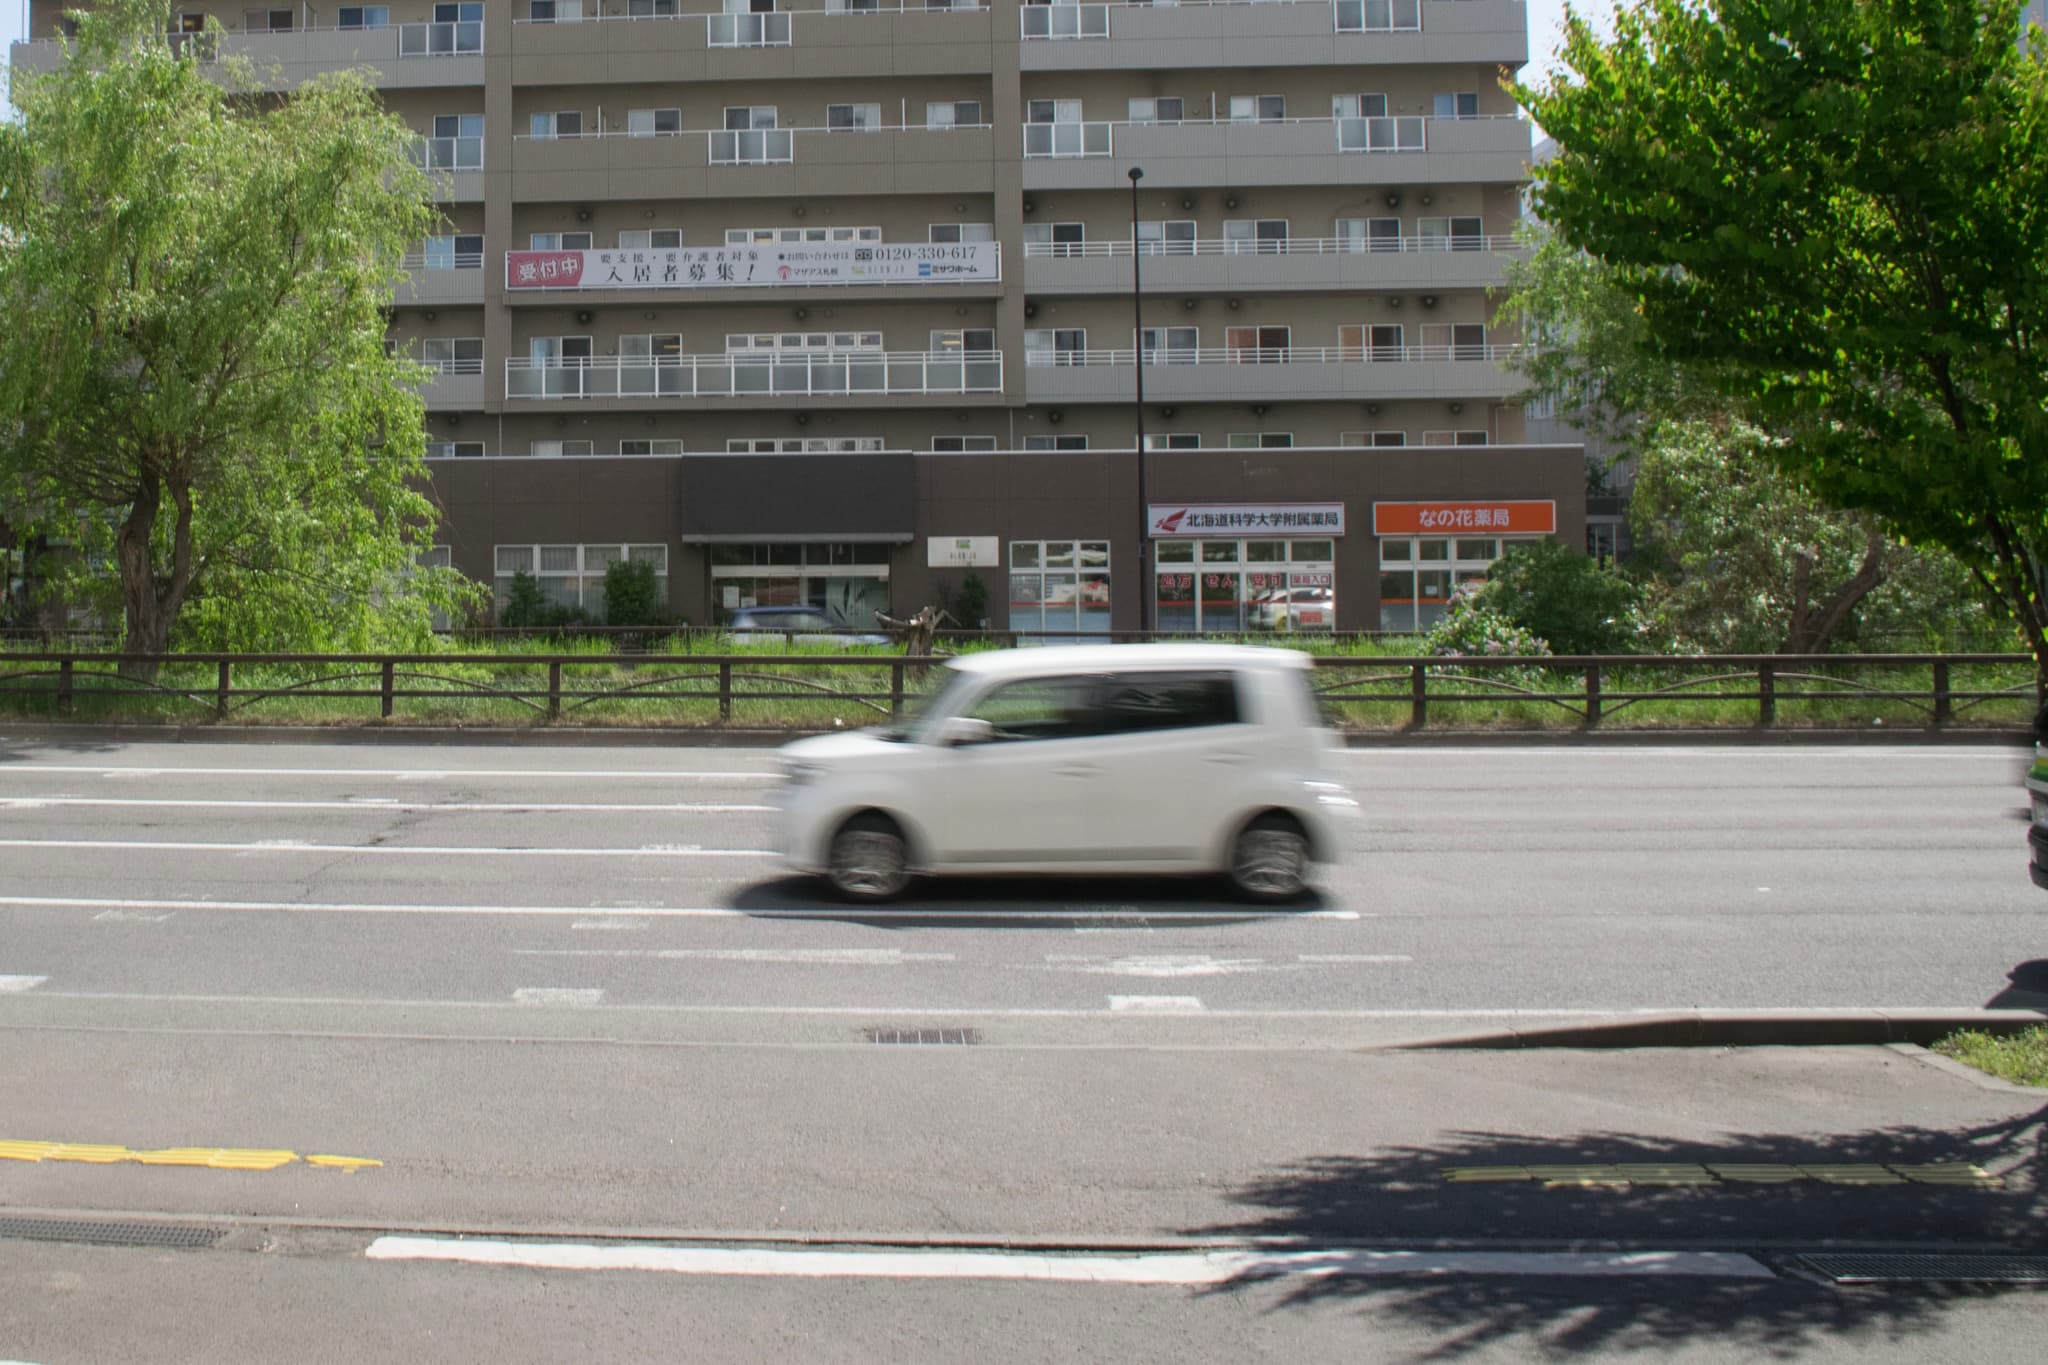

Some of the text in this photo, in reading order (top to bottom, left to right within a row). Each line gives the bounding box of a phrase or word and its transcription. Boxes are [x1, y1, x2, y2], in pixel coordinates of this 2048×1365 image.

[875, 246, 977, 261] 0120-330-617
[517, 255, 579, 282] 受付中
[932, 264, 977, 273] ミサワホーム
[1186, 512, 1339, 527] 北海道科学大学附属薬局
[1418, 509, 1510, 527] なの花薬局
